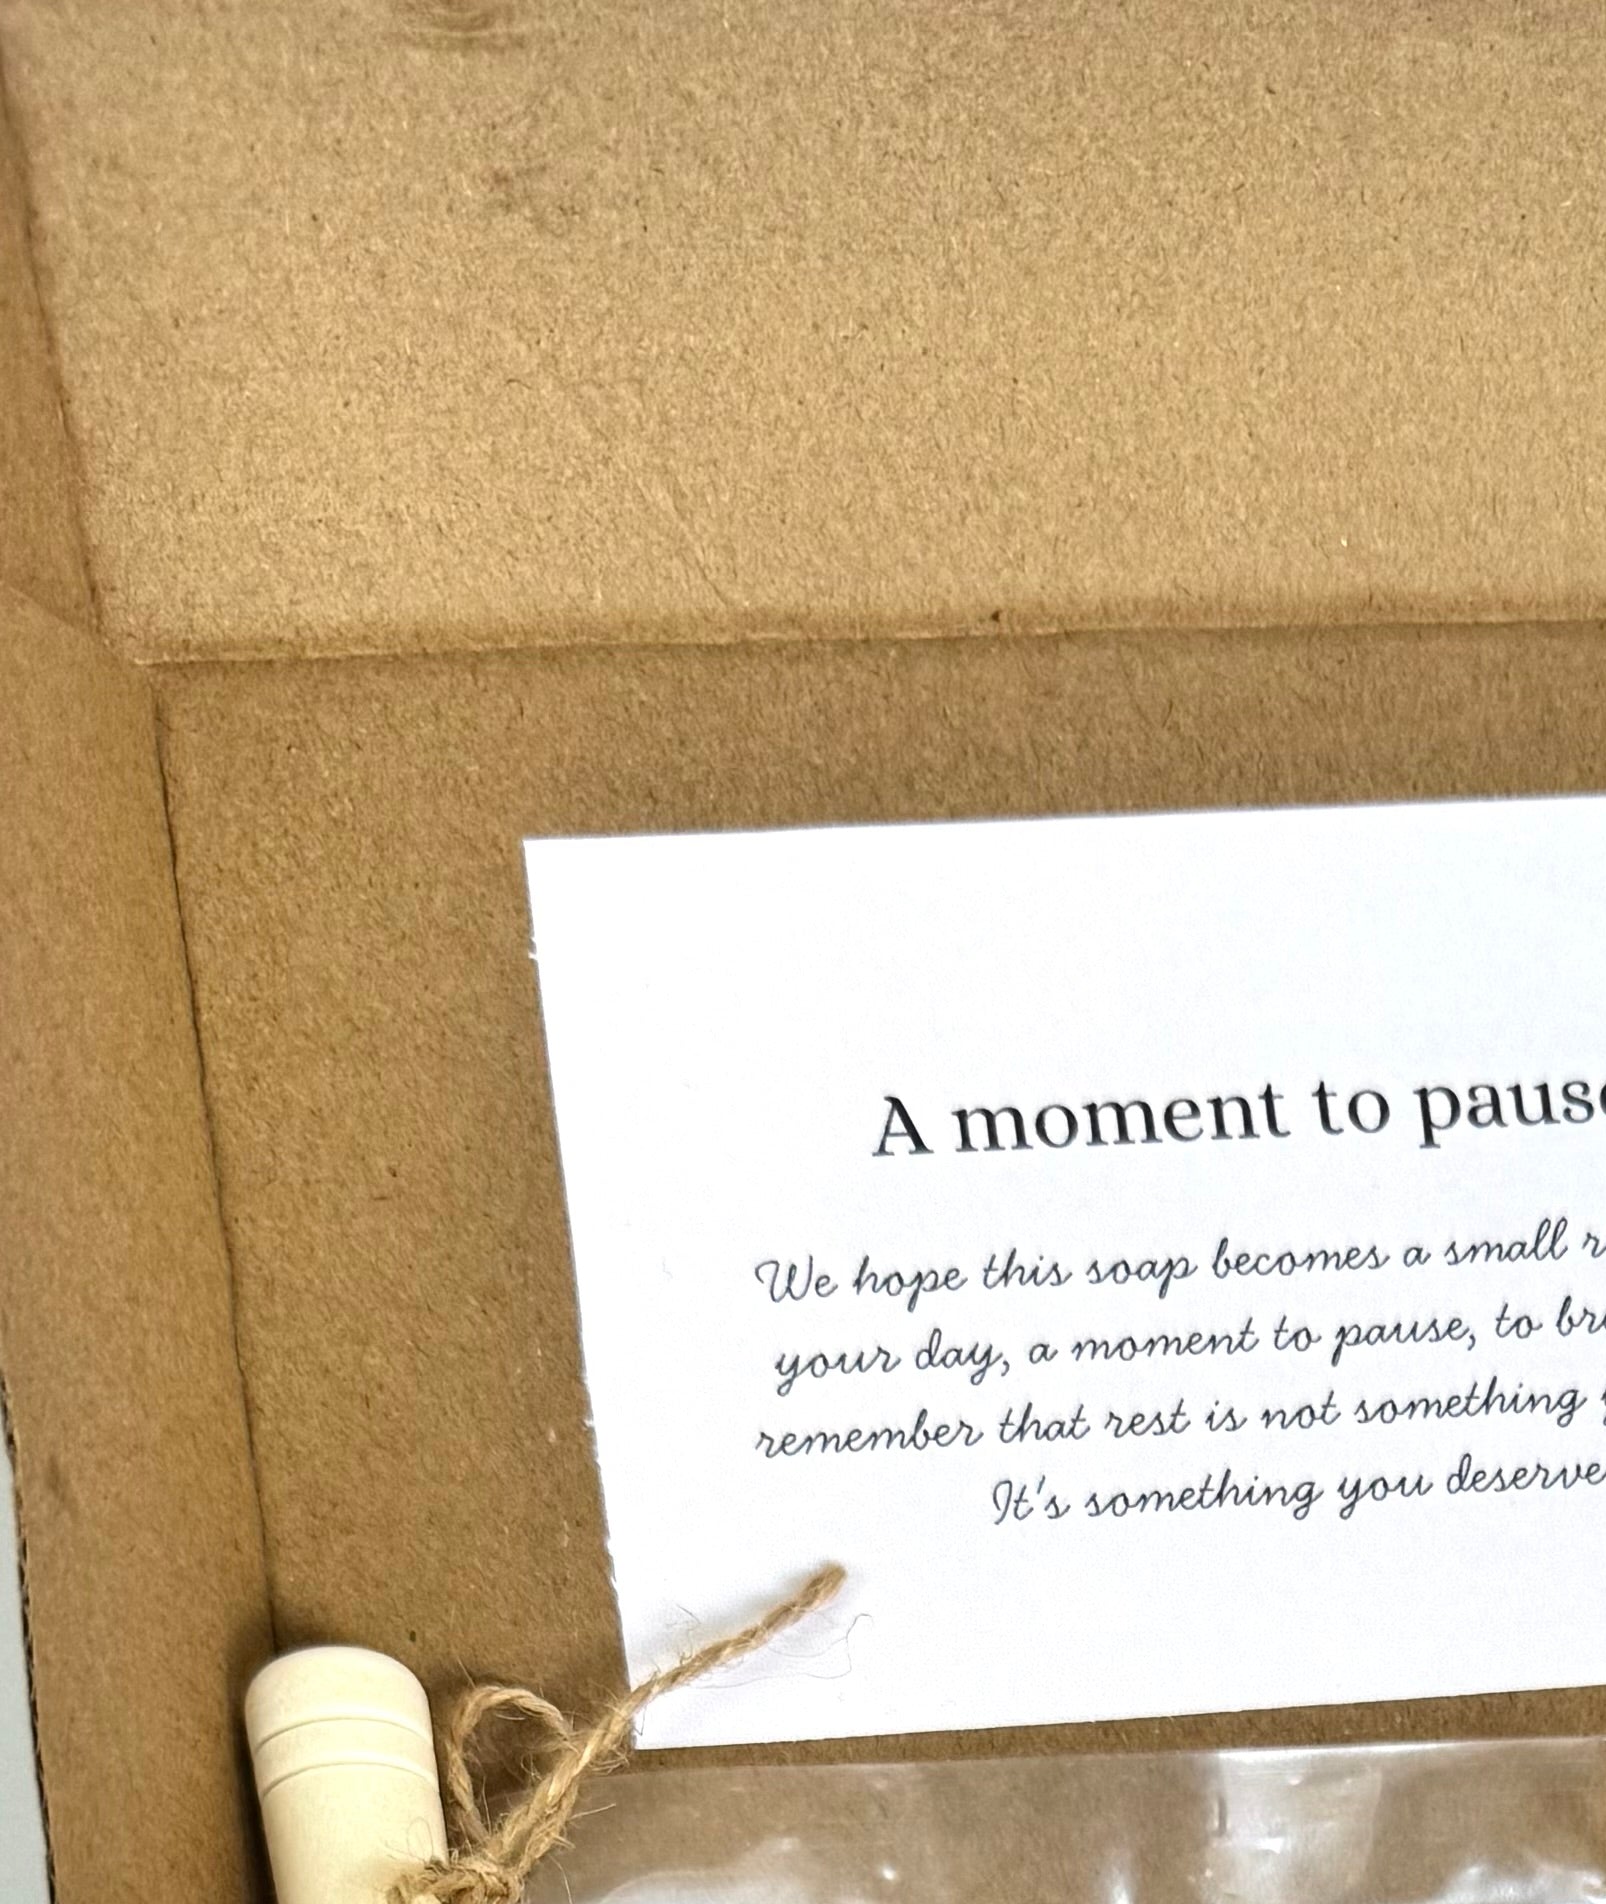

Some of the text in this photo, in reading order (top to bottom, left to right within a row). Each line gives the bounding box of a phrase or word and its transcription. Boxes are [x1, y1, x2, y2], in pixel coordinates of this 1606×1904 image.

[870, 1093, 936, 1159] A
[949, 1081, 1293, 1154] moment
[1310, 1078, 1392, 1137] to
[753, 1253, 840, 1305] We
[850, 1253, 970, 1315] hope
[981, 1246, 1074, 1291] this
[1084, 1254, 1200, 1301] soap
[1210, 1235, 1392, 1281] becomes
[1401, 1244, 1433, 1269] a
[1442, 1214, 1570, 1268] small
[773, 1343, 903, 1399] your
[913, 1326, 1012, 1388] day,
[1027, 1341, 1060, 1366] a
[1069, 1315, 1261, 1363] moment
[1272, 1312, 1324, 1354] to
[1329, 1315, 1478, 1369] pause,
[1493, 1301, 1545, 1341] to
[753, 1406, 986, 1460] remember
[997, 1400, 1093, 1445] that
[1102, 1396, 1193, 1440] rest
[1203, 1398, 1249, 1434] is
[1258, 1388, 1343, 1431] not
[1352, 1373, 1589, 1430] something
[990, 1473, 1073, 1527] It's
[1082, 1466, 1326, 1522] something
[1335, 1472, 1435, 1522] you
